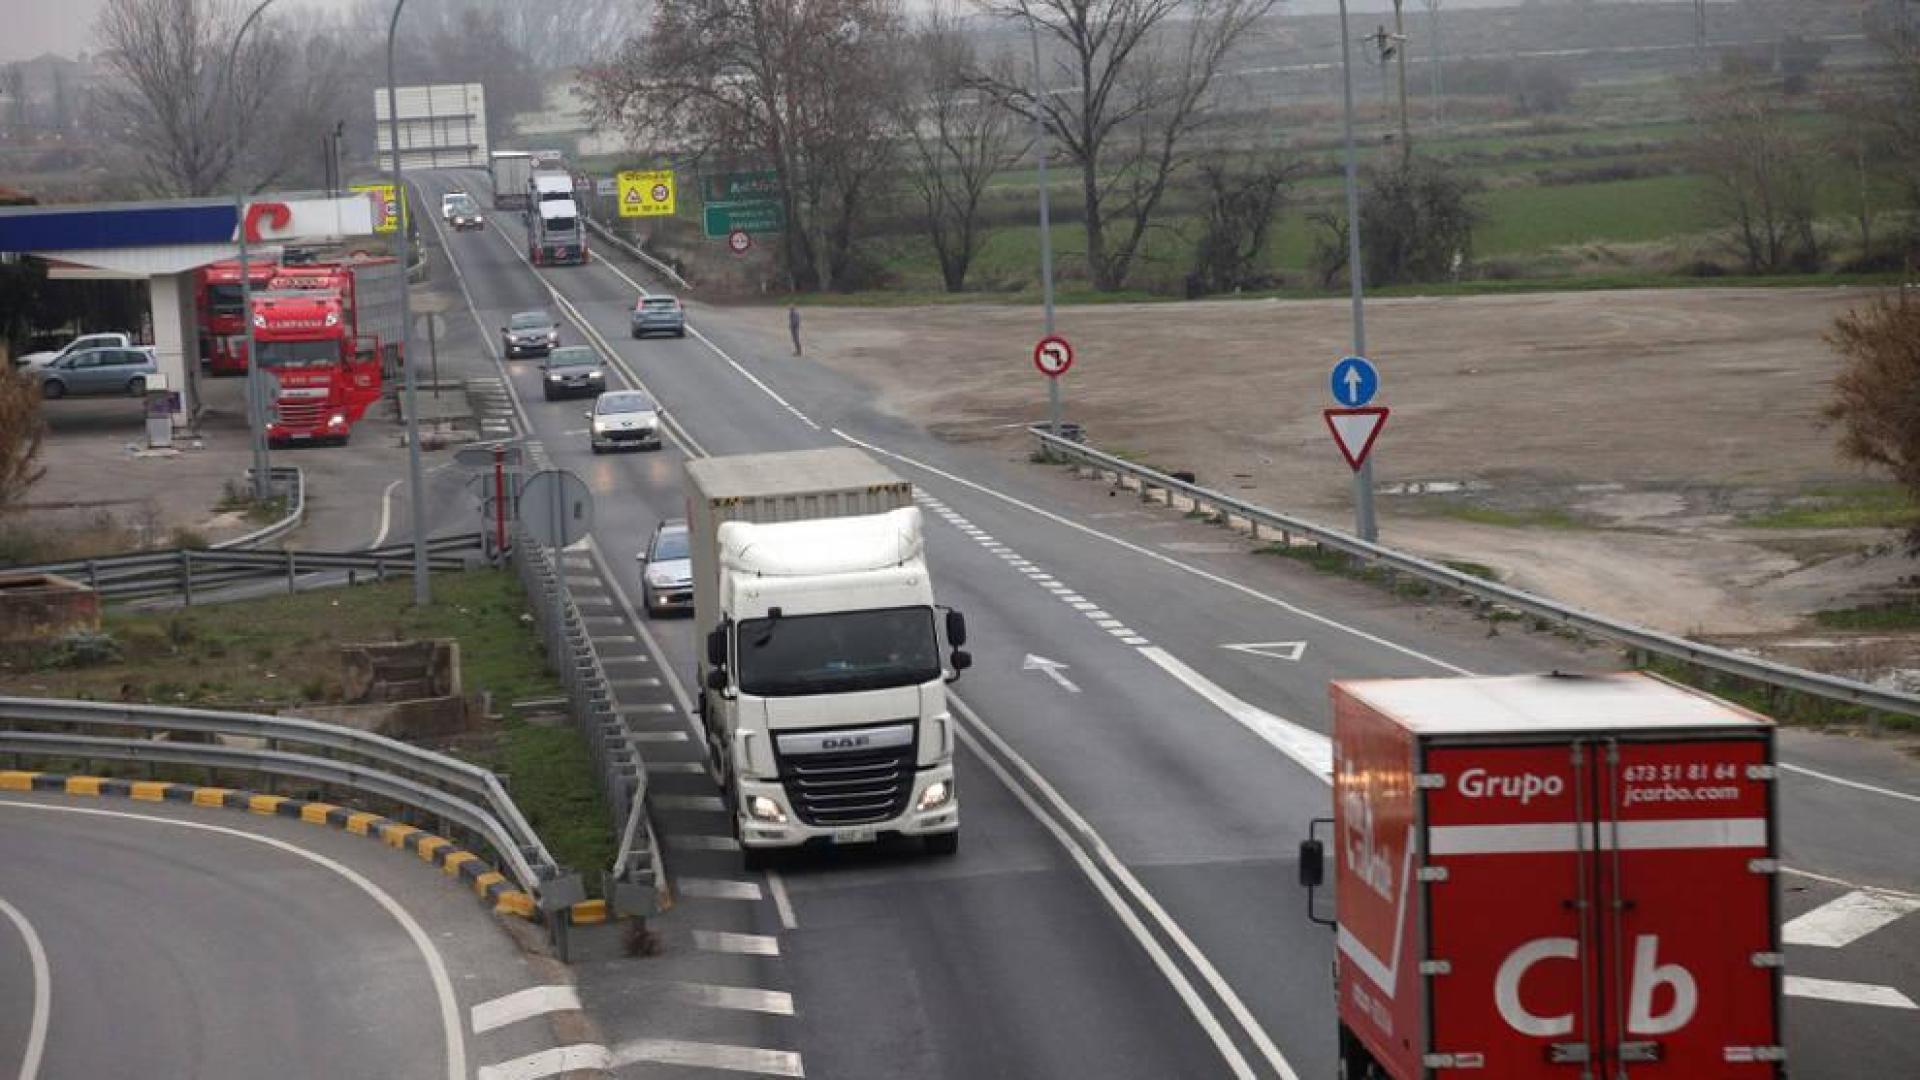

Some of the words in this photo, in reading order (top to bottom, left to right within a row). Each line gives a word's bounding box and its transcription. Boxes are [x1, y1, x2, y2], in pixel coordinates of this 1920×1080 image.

[822, 735, 869, 749] DAF
[1623, 765, 1658, 780] 673
[1661, 764, 1682, 780] 51
[1688, 763, 1708, 779] 81
[1714, 763, 1737, 779] 64
[1458, 768, 1563, 804] Grupo
[1622, 783, 1739, 808] jcarbo.com
